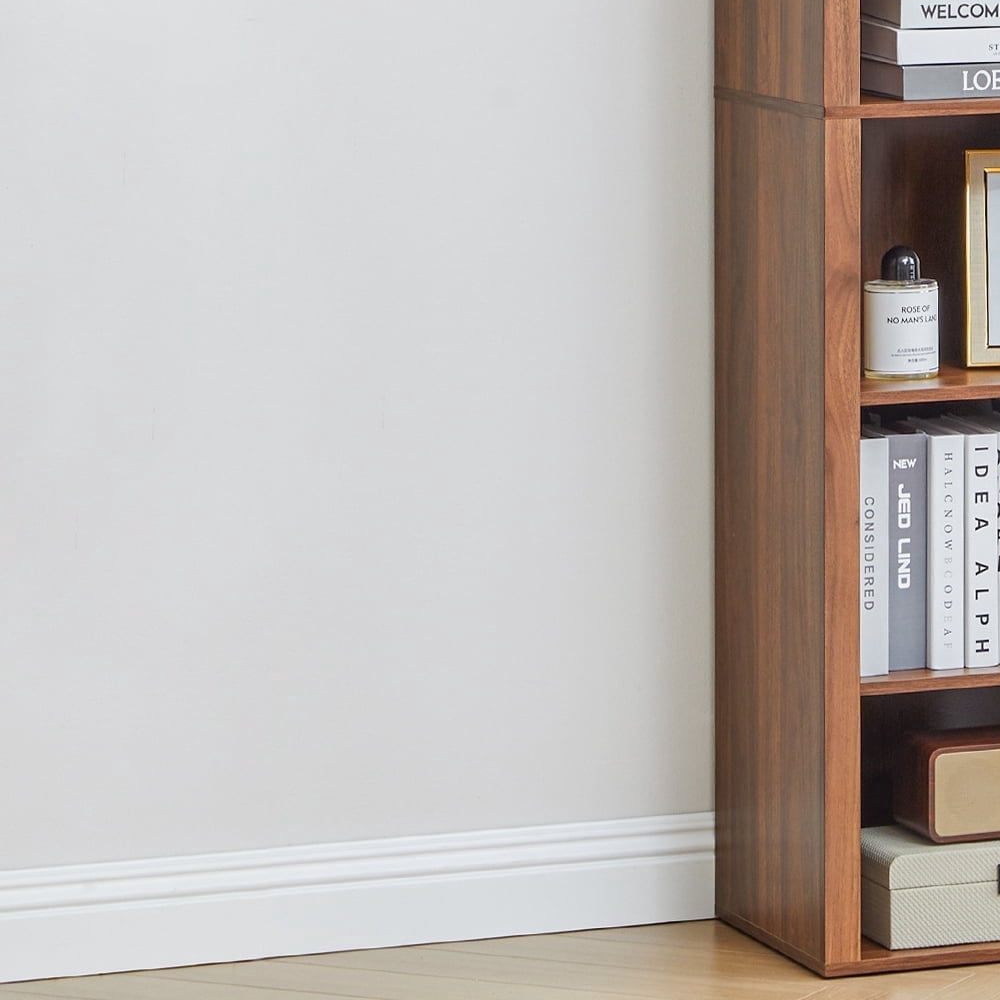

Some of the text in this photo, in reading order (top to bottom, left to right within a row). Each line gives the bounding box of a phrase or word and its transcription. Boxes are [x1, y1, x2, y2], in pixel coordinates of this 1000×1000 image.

[901, 304, 931, 313] ROSE OF
[901, 316, 924, 324] MAN'S
[893, 458, 917, 469] NEW
[897, 483, 911, 590] JED LIND
[863, 496, 875, 611] CONSIDERED
